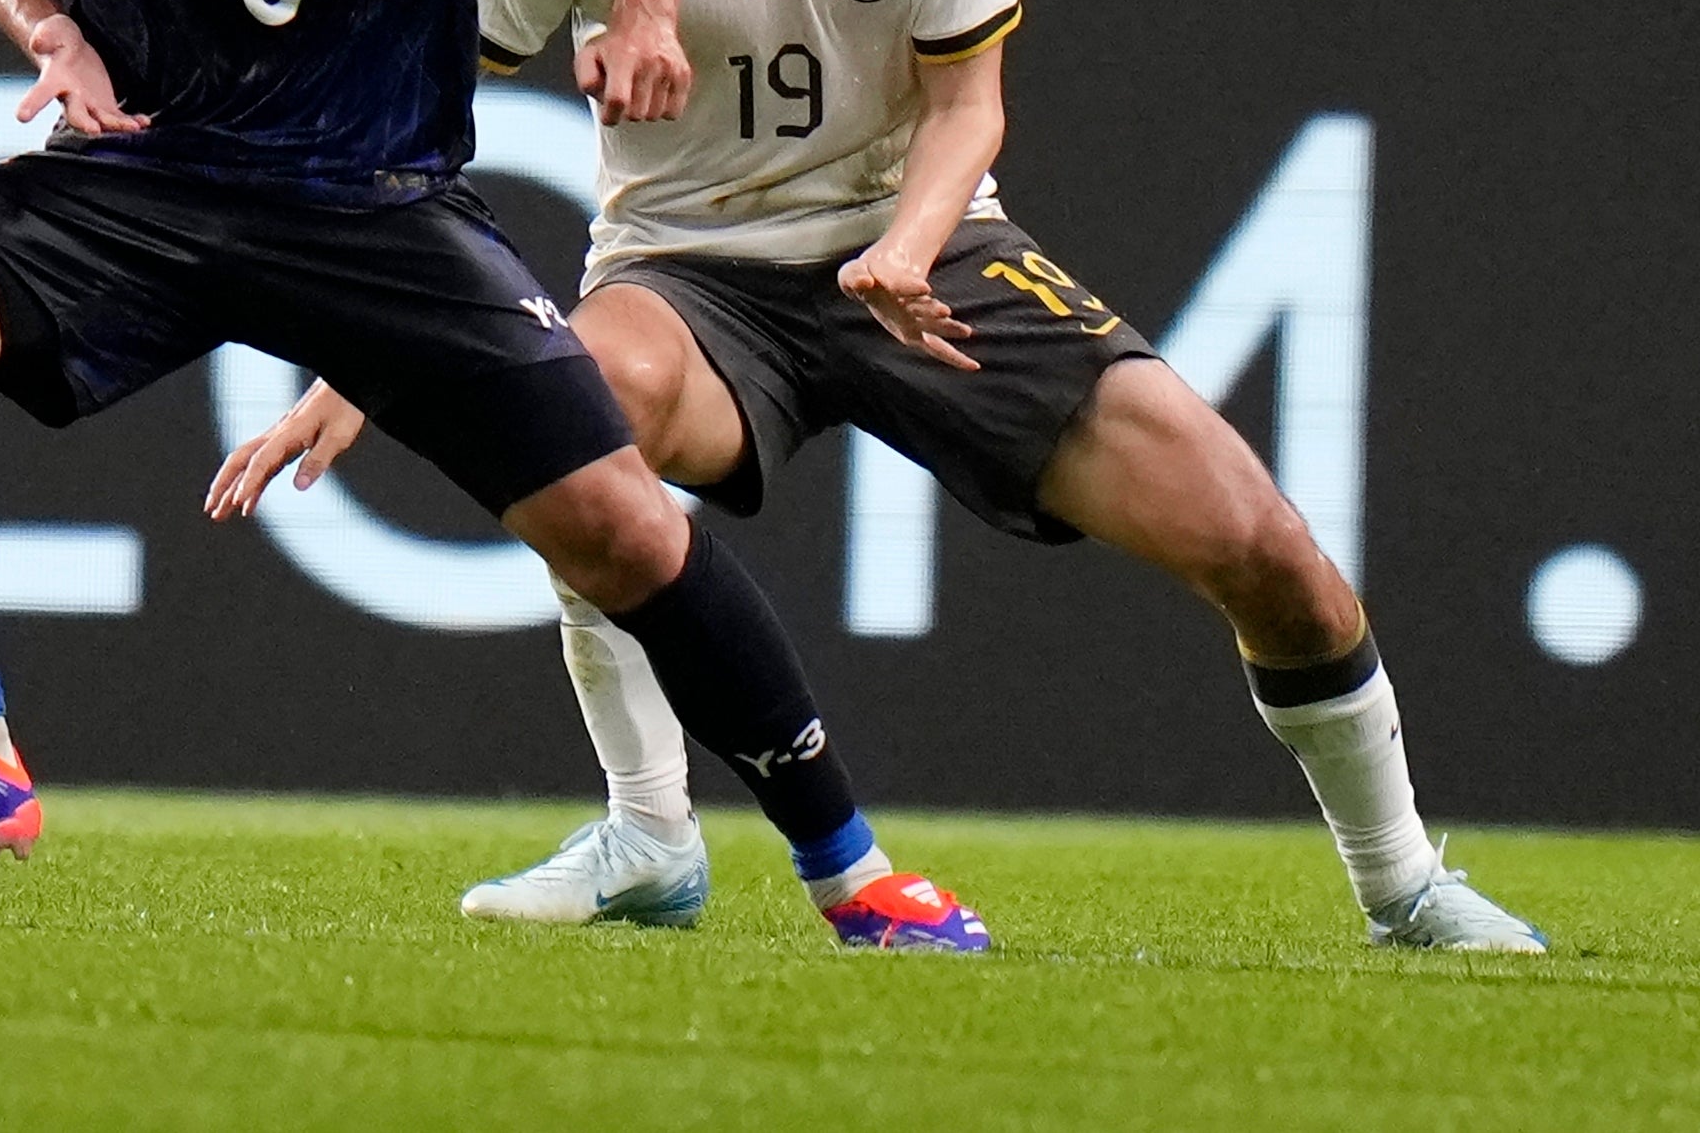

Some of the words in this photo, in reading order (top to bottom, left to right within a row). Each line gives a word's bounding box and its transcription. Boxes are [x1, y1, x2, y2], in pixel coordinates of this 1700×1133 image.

[727, 43, 823, 139] 19
[981, 250, 1106, 317] 19
[734, 717, 827, 778] Y-3
